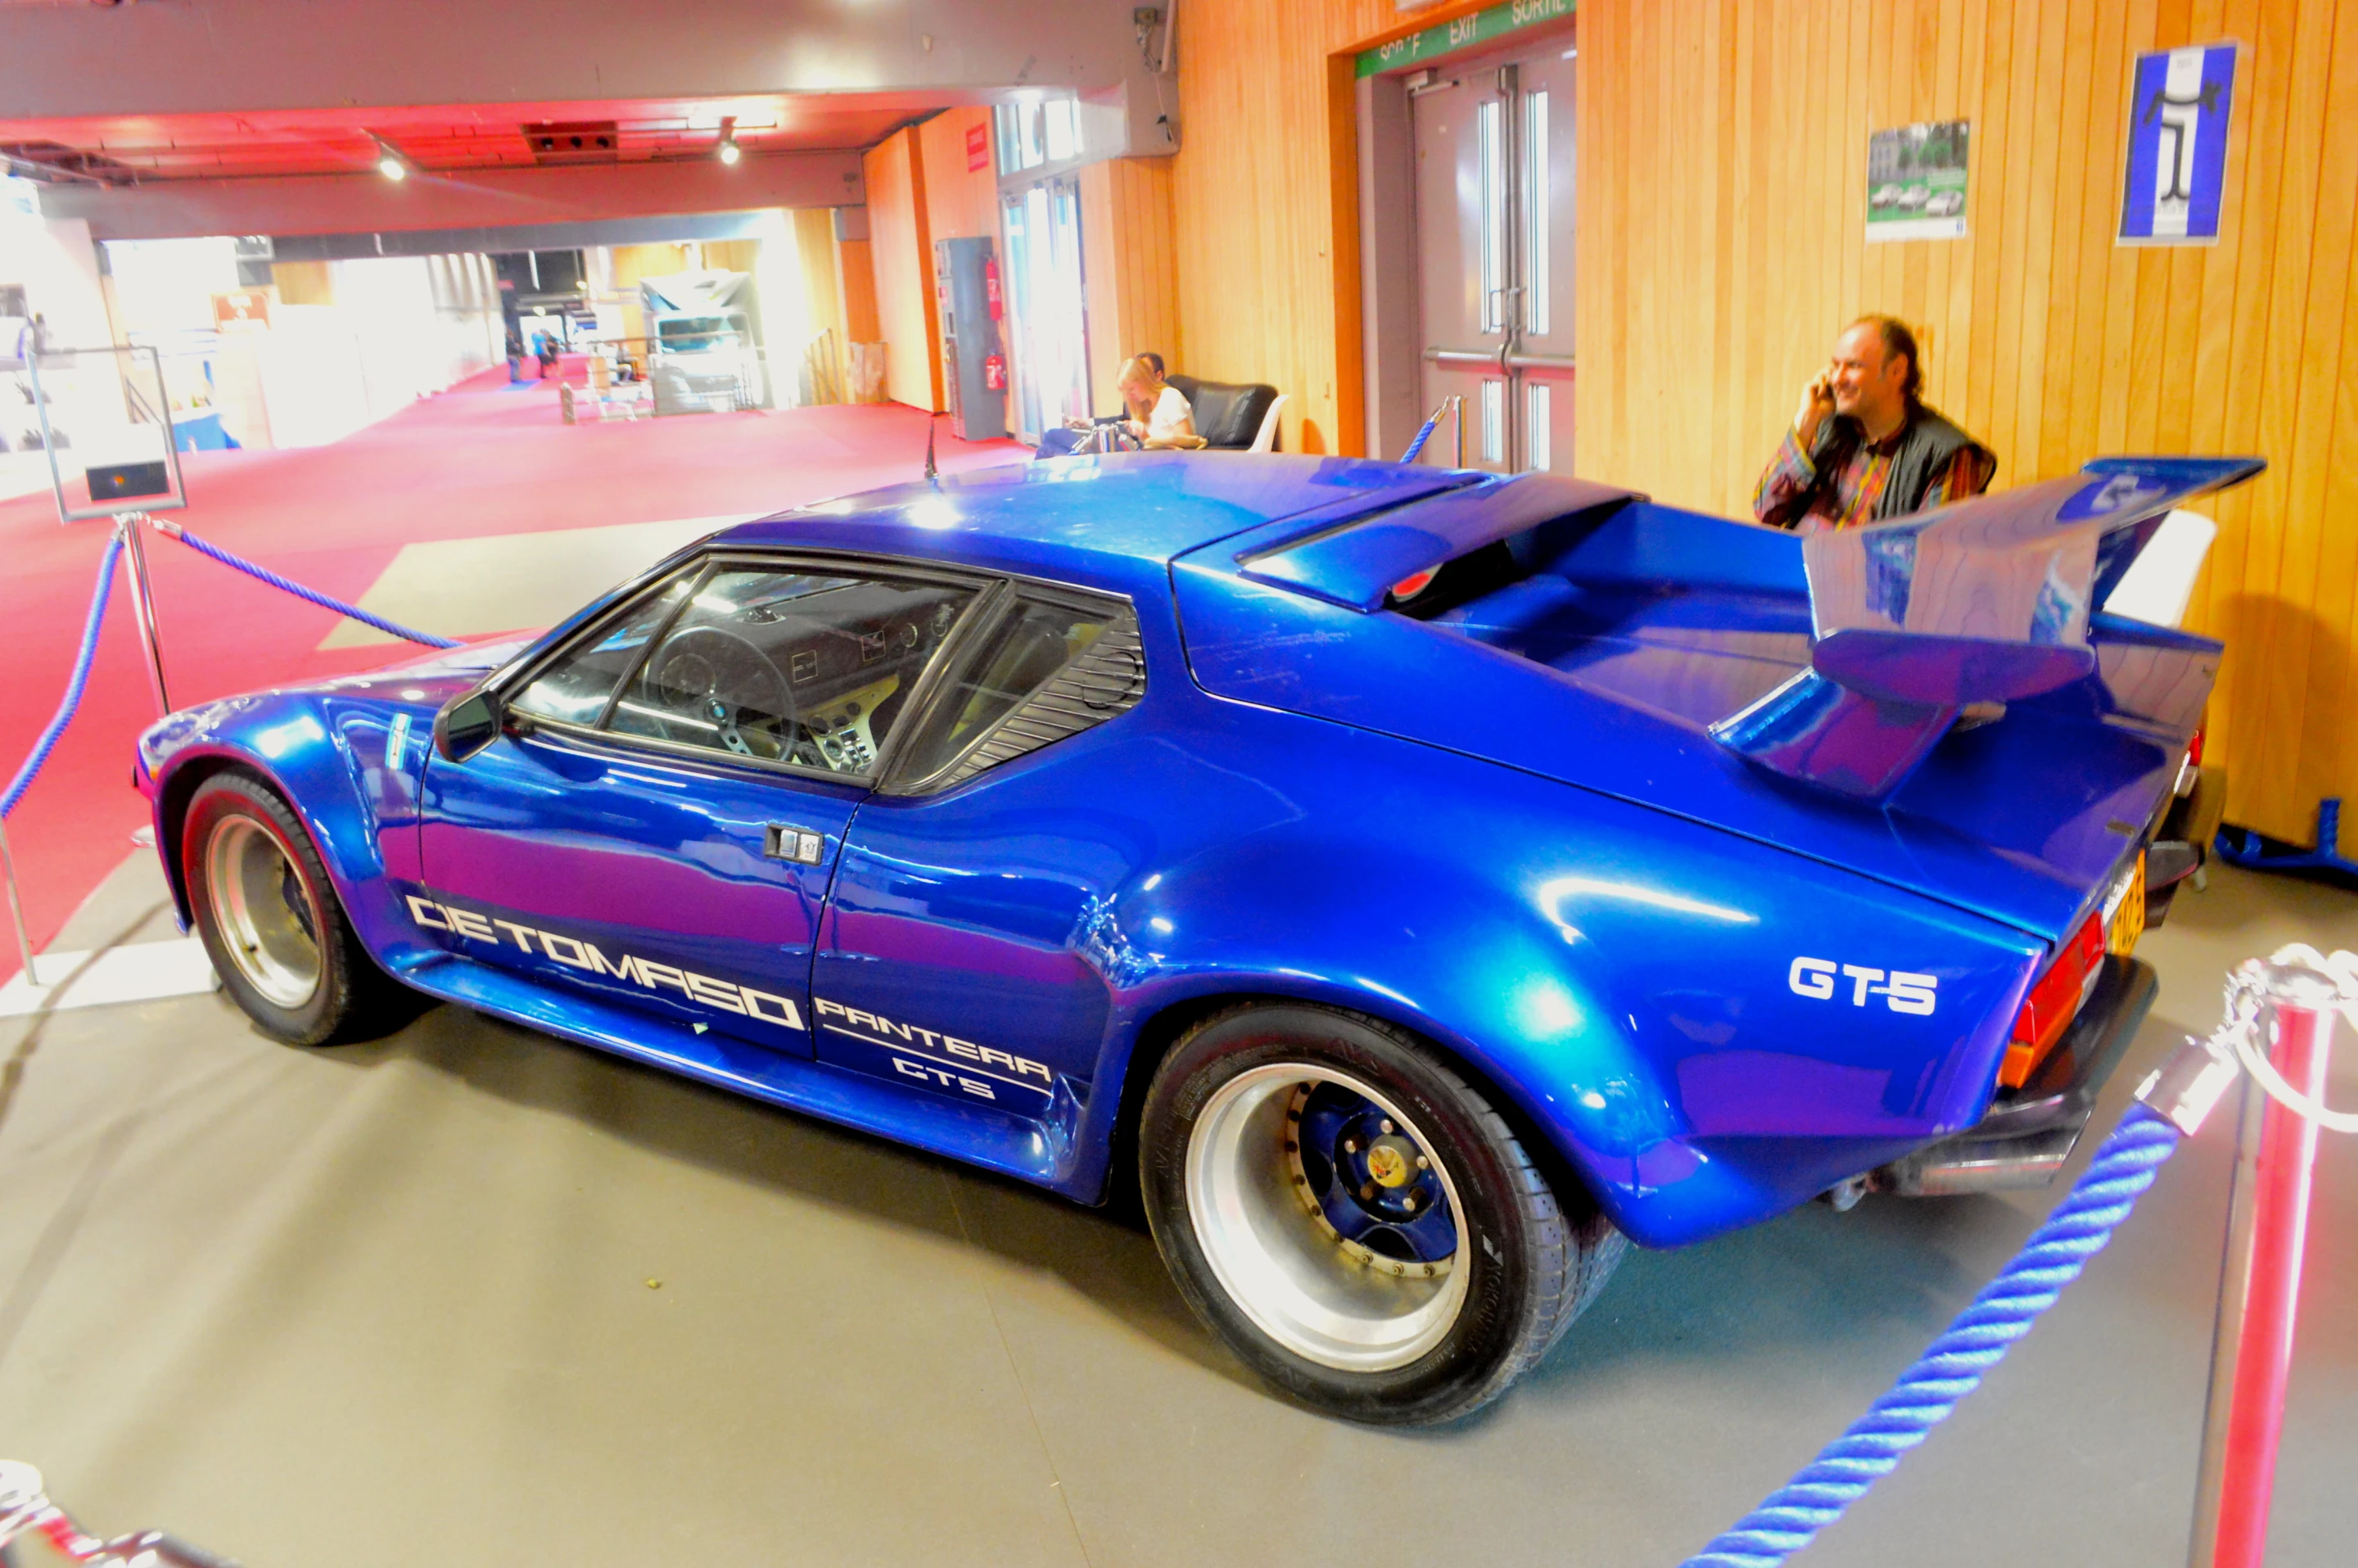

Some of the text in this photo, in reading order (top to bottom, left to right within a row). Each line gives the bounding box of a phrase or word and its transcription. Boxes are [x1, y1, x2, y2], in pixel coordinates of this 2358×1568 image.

[1449, 11, 1479, 46] EXIT
[814, 996, 1052, 1083] PANTERA
[892, 1056, 996, 1100] GTS
